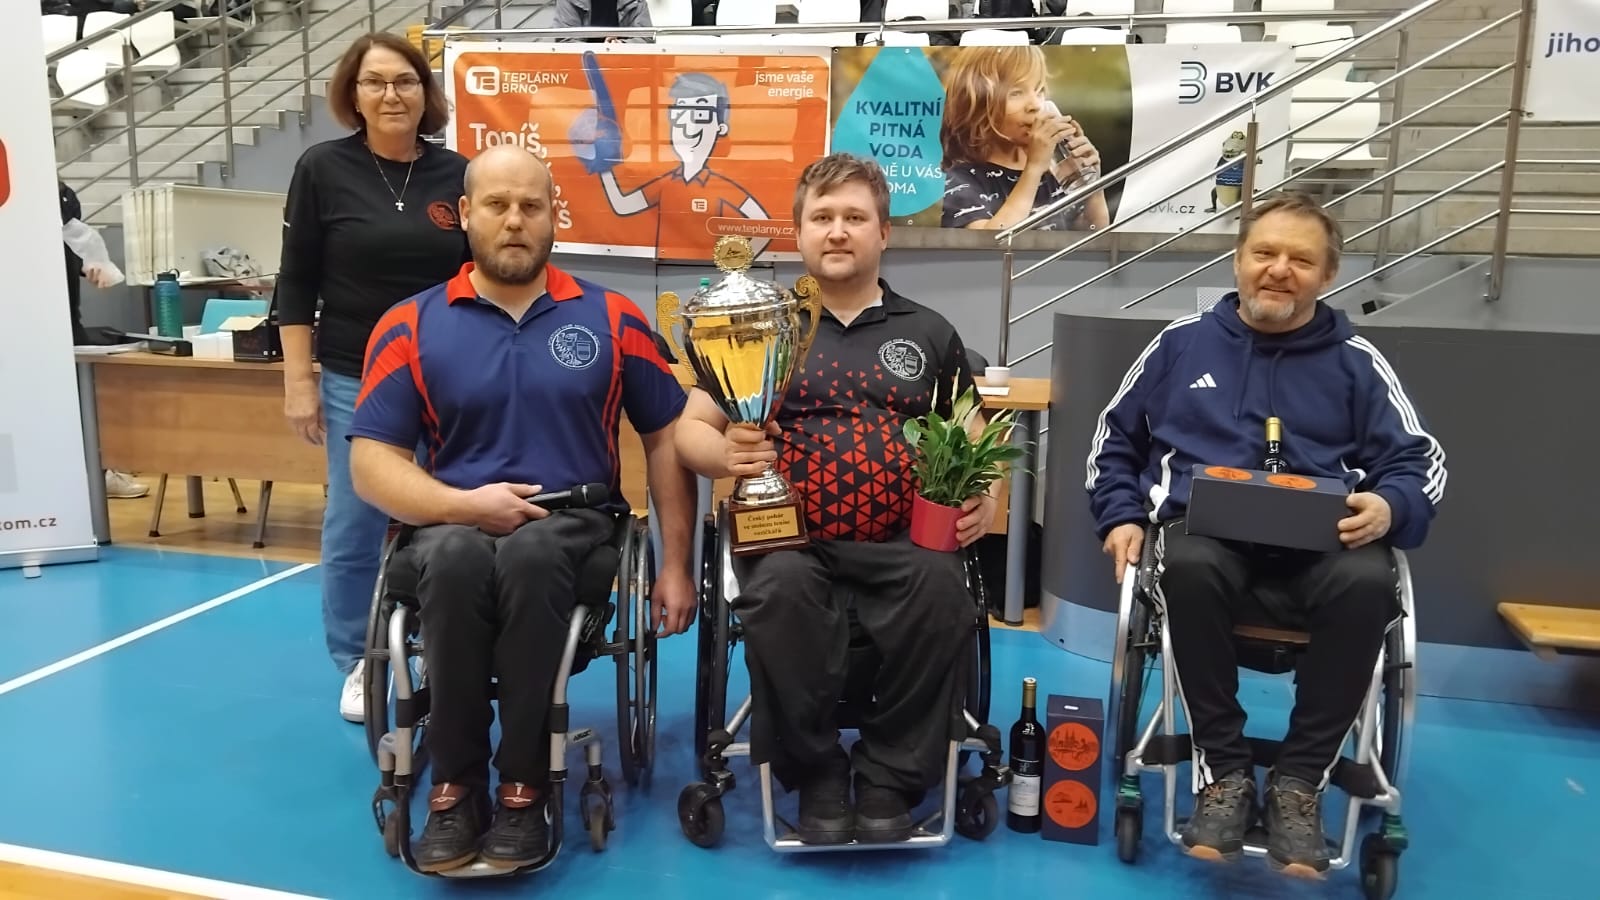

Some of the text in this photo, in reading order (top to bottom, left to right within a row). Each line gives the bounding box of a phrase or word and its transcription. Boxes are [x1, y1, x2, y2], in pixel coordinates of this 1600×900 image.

[503, 71, 568, 84] TEPLÁRNY
[754, 70, 814, 87] jsme vaše
[1216, 72, 1275, 93] BVK
[502, 83, 538, 94] BRNO
[767, 85, 814, 99] energie
[856, 97, 942, 117] KVALITNÍ
[870, 119, 926, 138] PITNÁ
[869, 142, 923, 159] VODA
[901, 165, 912, 177] U
[915, 163, 943, 179] VÁS
[718, 223, 794, 236] www.teplarny.cz
[0, 517, 57, 531] om.cz
